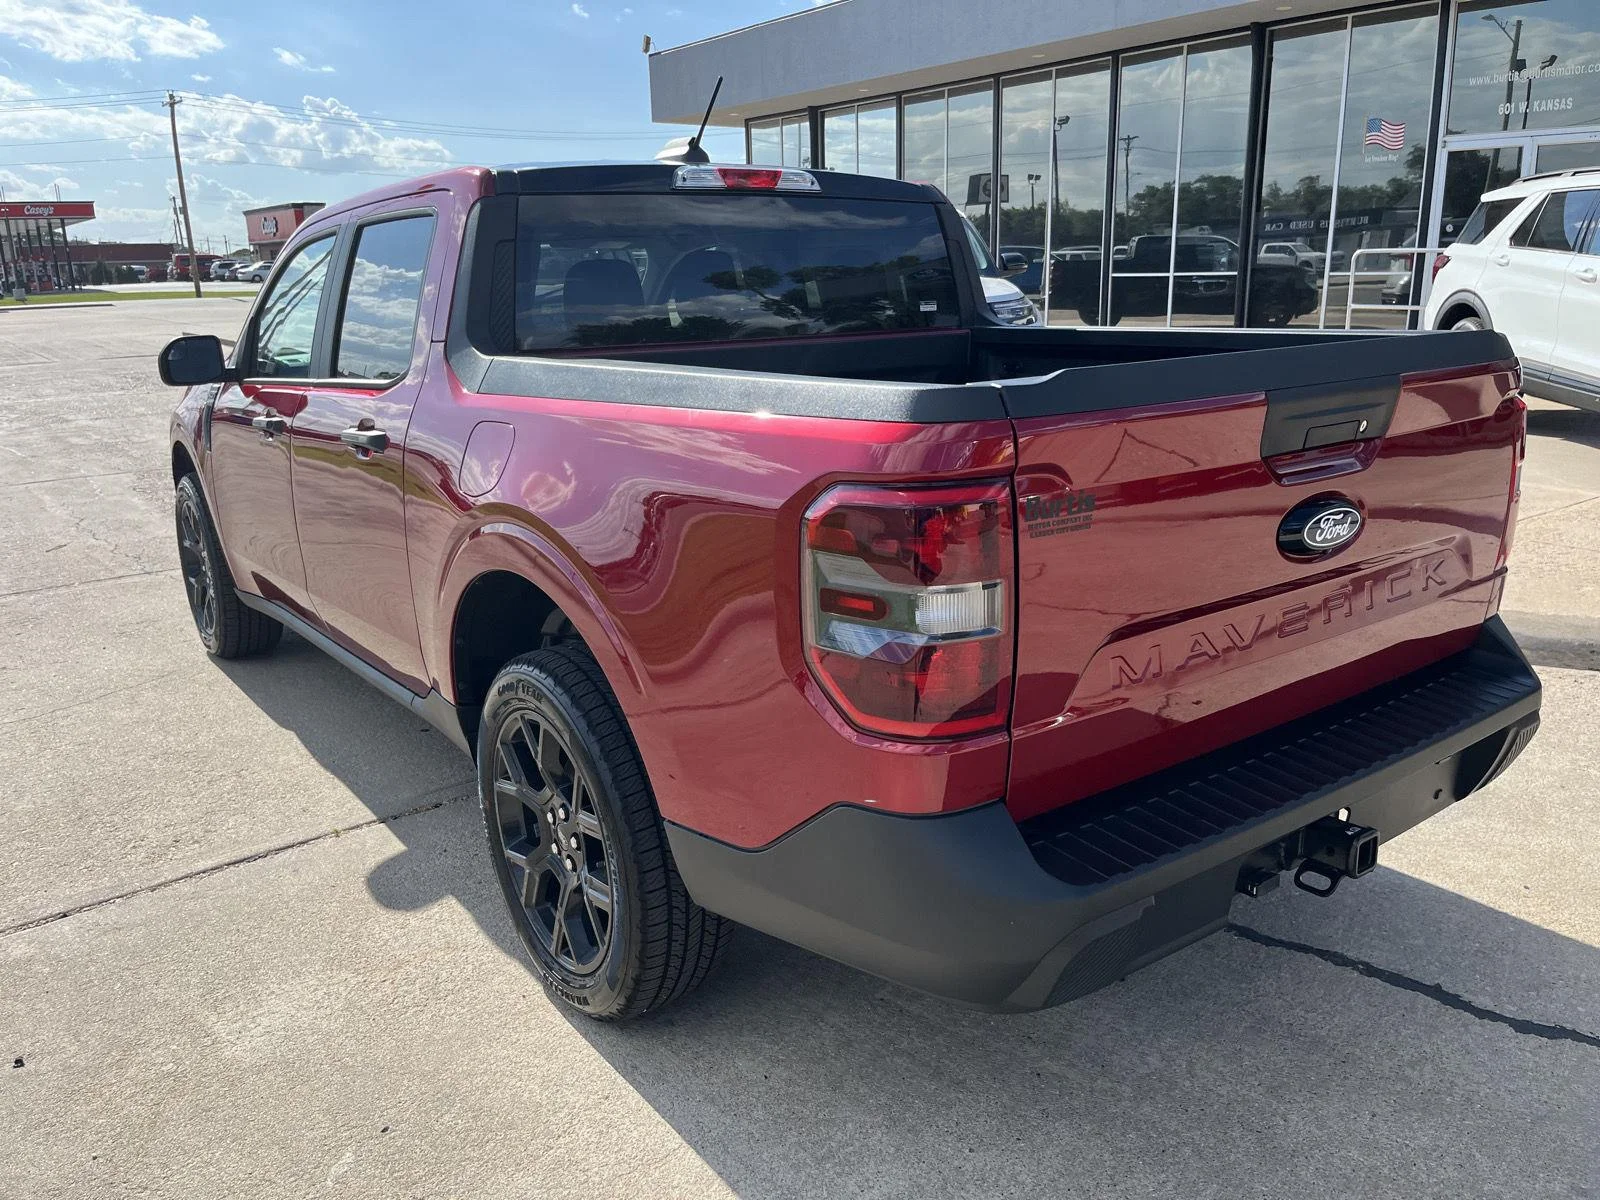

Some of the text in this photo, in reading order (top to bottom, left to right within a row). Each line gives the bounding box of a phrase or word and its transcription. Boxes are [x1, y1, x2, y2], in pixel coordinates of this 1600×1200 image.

[1499, 97, 1573, 115] 601 W. KANSAS
[24, 205, 54, 216] Casey's
[1315, 513, 1351, 542] Ford
[1111, 556, 1447, 690] MAVERICK
